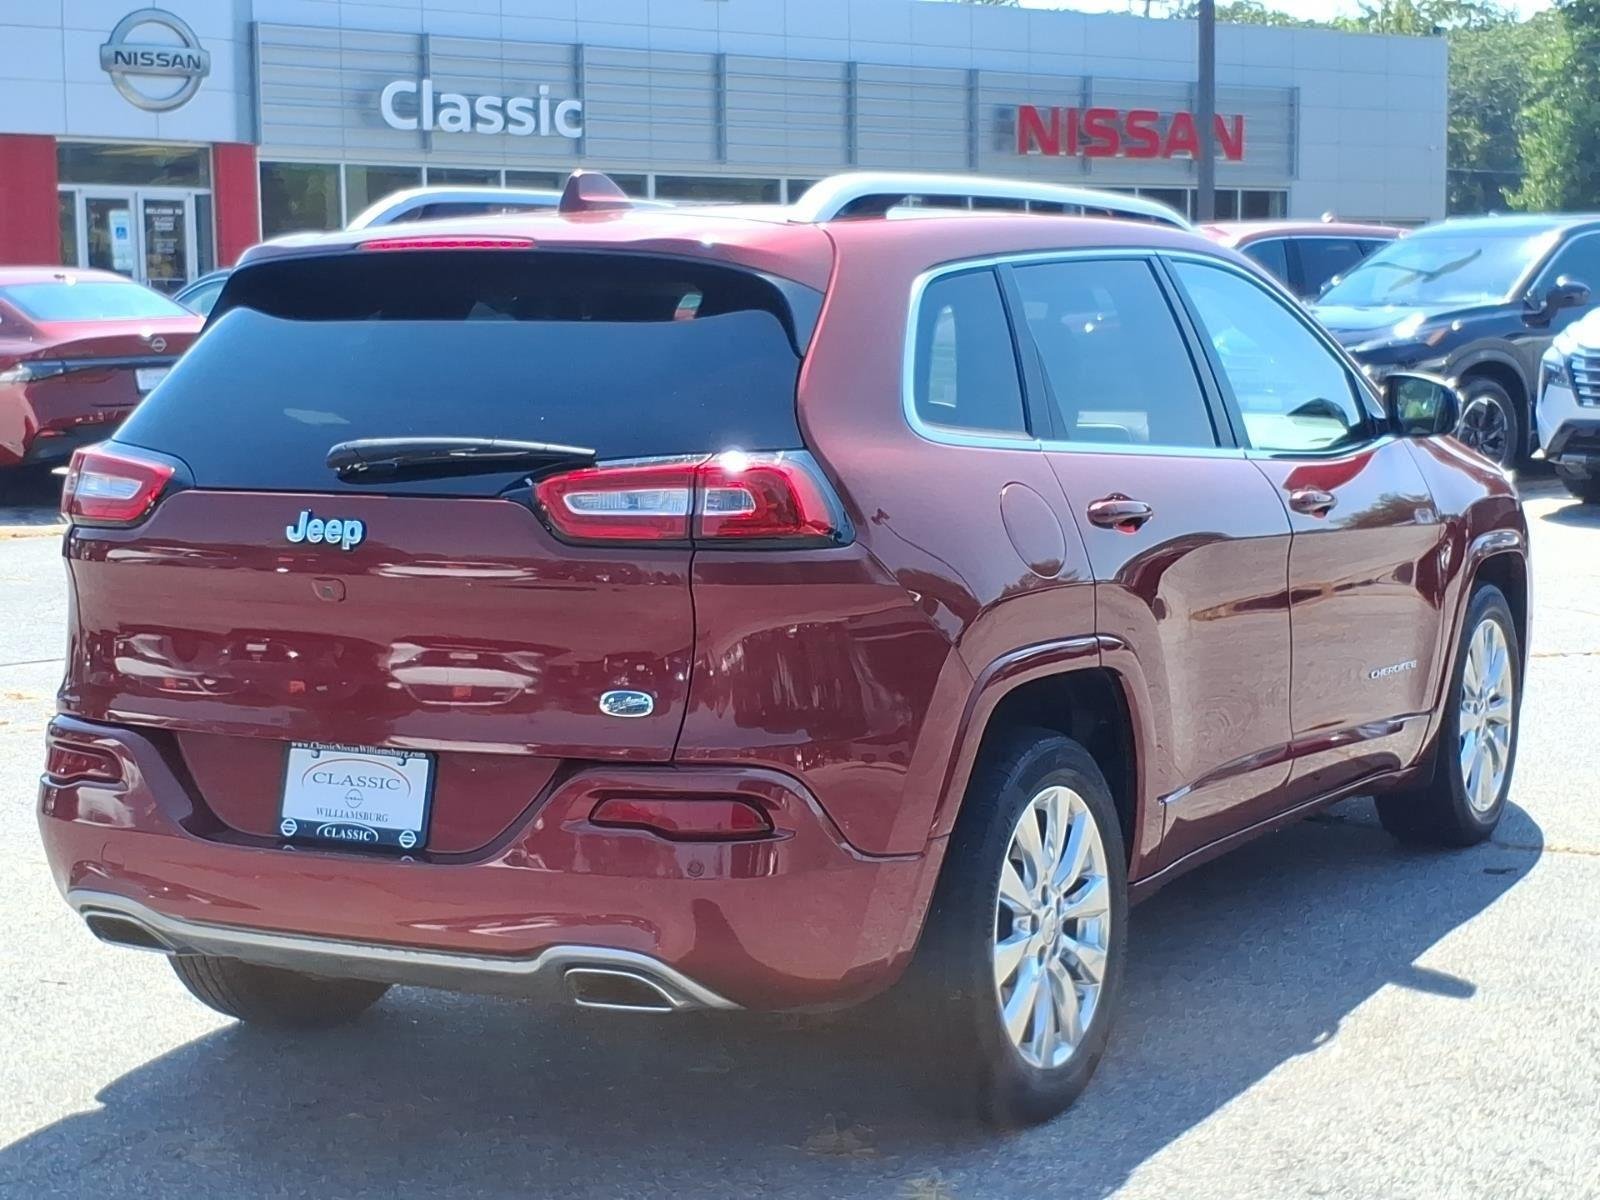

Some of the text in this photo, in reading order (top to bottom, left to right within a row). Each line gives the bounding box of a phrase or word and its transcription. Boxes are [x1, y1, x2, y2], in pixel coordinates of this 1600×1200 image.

[114, 50, 201, 70] NISSAN
[380, 79, 583, 138] Classic
[1017, 104, 1245, 161] NISSAN
[285, 510, 364, 551] Jeep
[313, 772, 400, 790] CLASSIC
[316, 808, 388, 822] WILLIAMSBURG
[324, 827, 371, 841] CLASSIC
